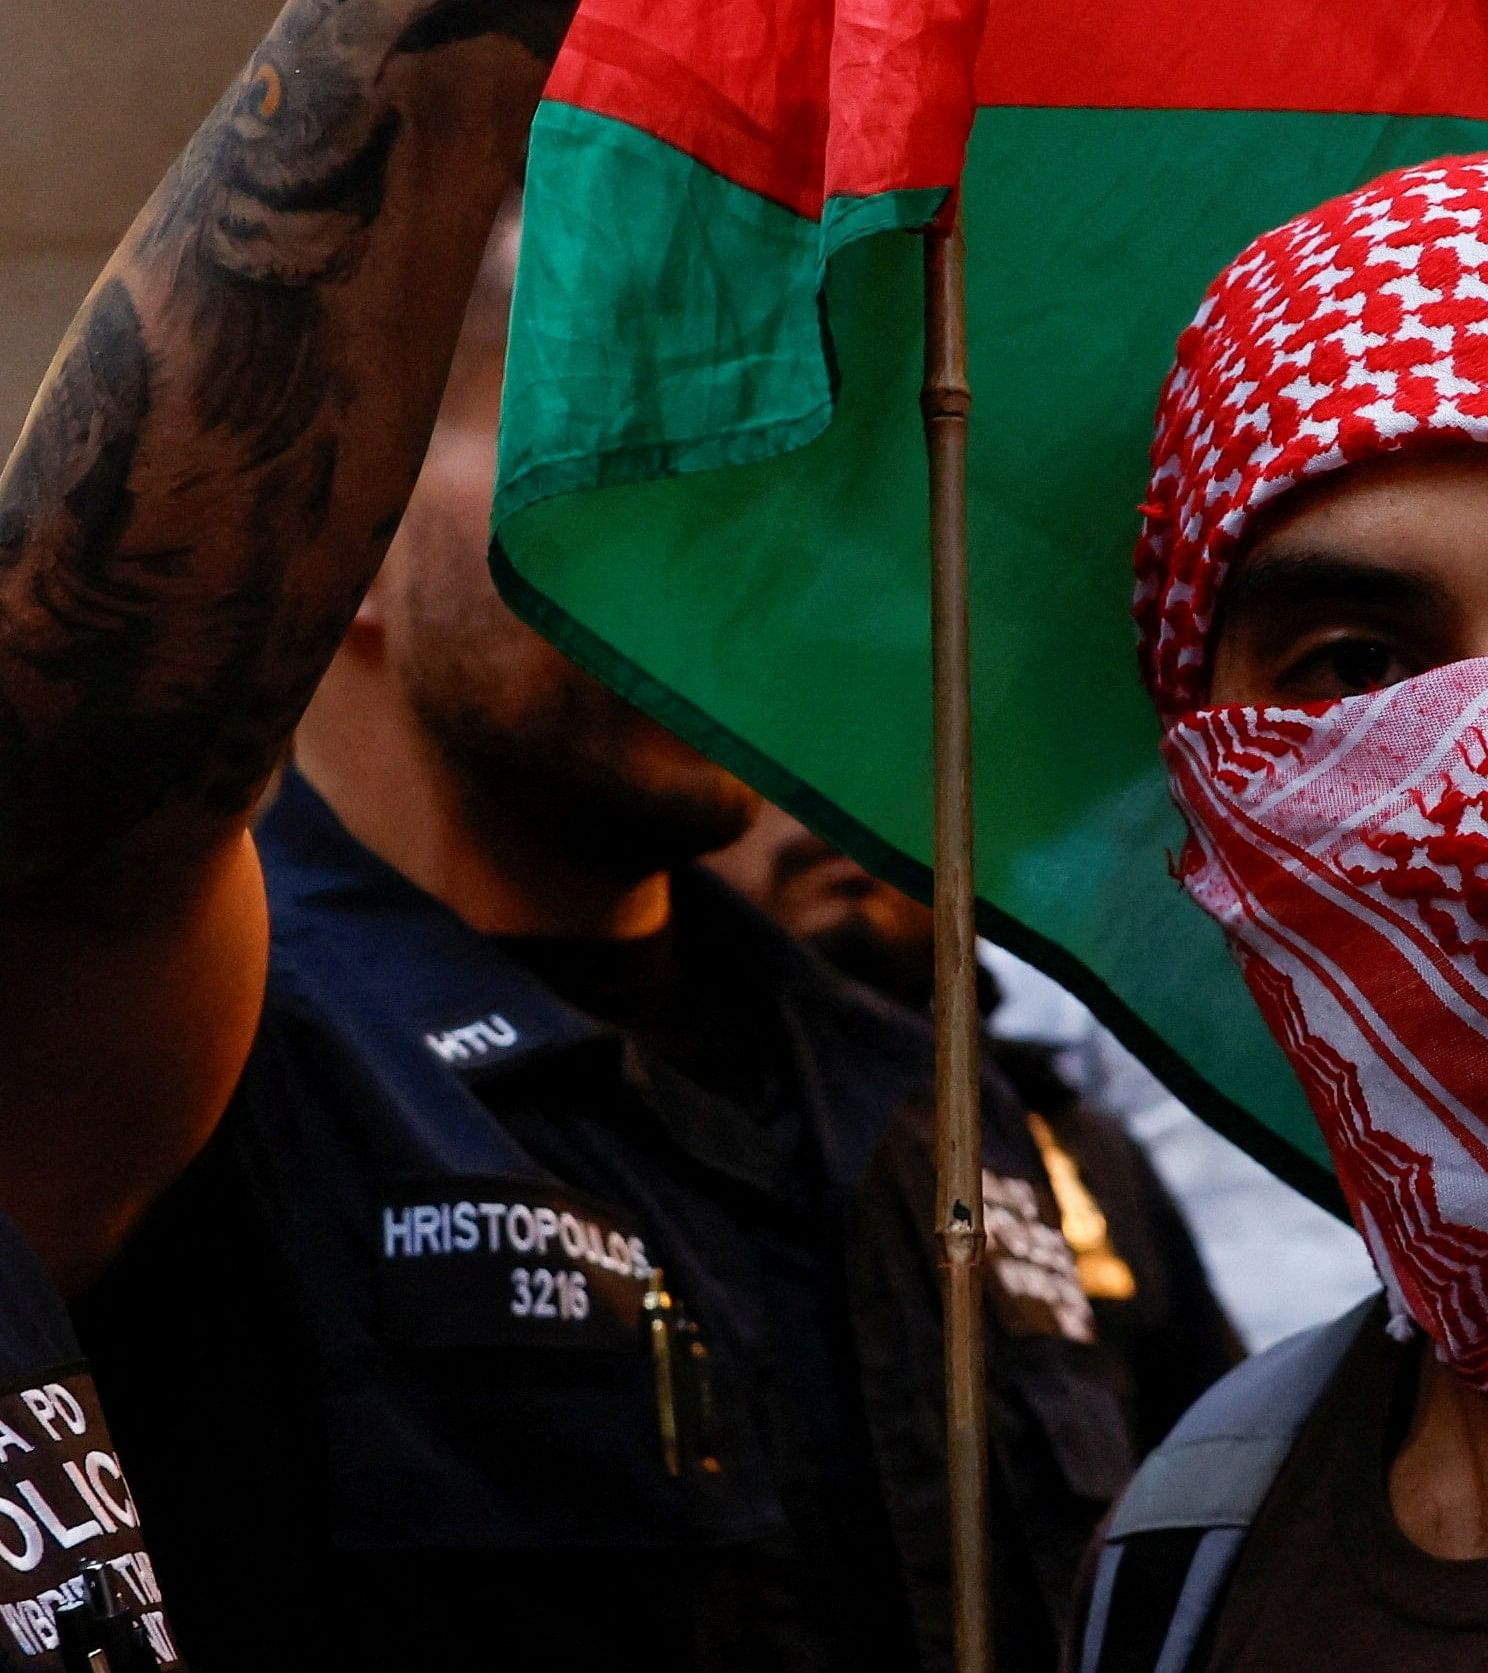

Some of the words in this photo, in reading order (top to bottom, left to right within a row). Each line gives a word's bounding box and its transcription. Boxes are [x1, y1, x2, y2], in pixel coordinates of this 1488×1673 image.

[383, 1201, 652, 1280] HRISTOPOULOS
[510, 1266, 590, 1320] 3216
[20, 1383, 87, 1441] PD
